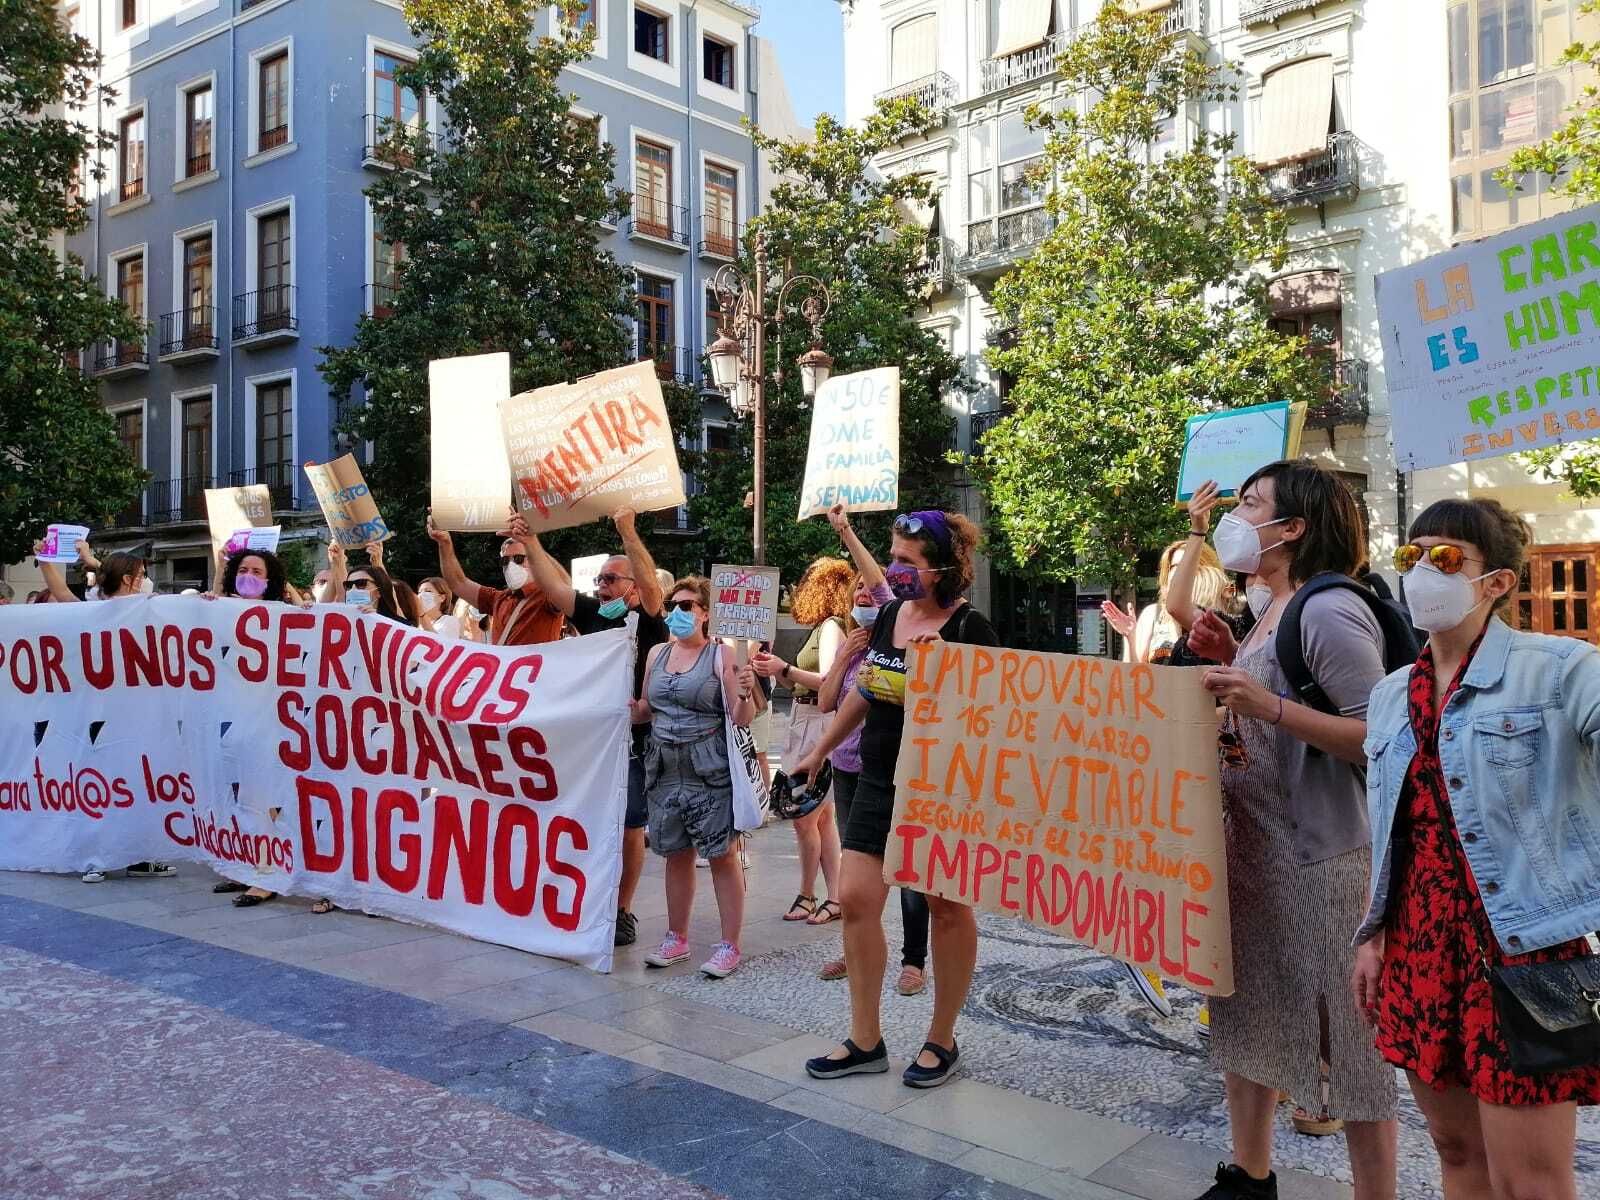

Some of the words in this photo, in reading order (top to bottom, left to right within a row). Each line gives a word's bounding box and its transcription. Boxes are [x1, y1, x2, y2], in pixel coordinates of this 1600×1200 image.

[1415, 263, 1475, 326] LA
[1497, 220, 1600, 293] CAR
[1426, 326, 1479, 372] ES
[1503, 279, 1600, 351] HUM
[519, 391, 662, 519] MENTIRA
[821, 418, 875, 446] OME
[719, 590, 740, 604] NO
[744, 590, 762, 605] ES
[0, 636, 71, 694] OR
[80, 625, 215, 690] UNOS
[236, 606, 543, 723] SERVICIOS
[875, 653, 891, 666] Can
[890, 656, 904, 669] Do
[909, 644, 1165, 720] IMPROVISAR
[277, 690, 558, 802] SOCIALES
[912, 698, 943, 725] EL
[1007, 707, 1039, 743] DE
[1053, 711, 1151, 764] MARZO
[33, 756, 135, 819] tod@s
[142, 754, 196, 805] los
[907, 737, 1199, 837] INEVITABLE
[296, 775, 588, 931] DIGNOS
[1044, 826, 1072, 857] EL
[1077, 832, 1106, 865] 26
[1113, 838, 1134, 871] DE
[894, 823, 1214, 987] IMPERDONABLE
